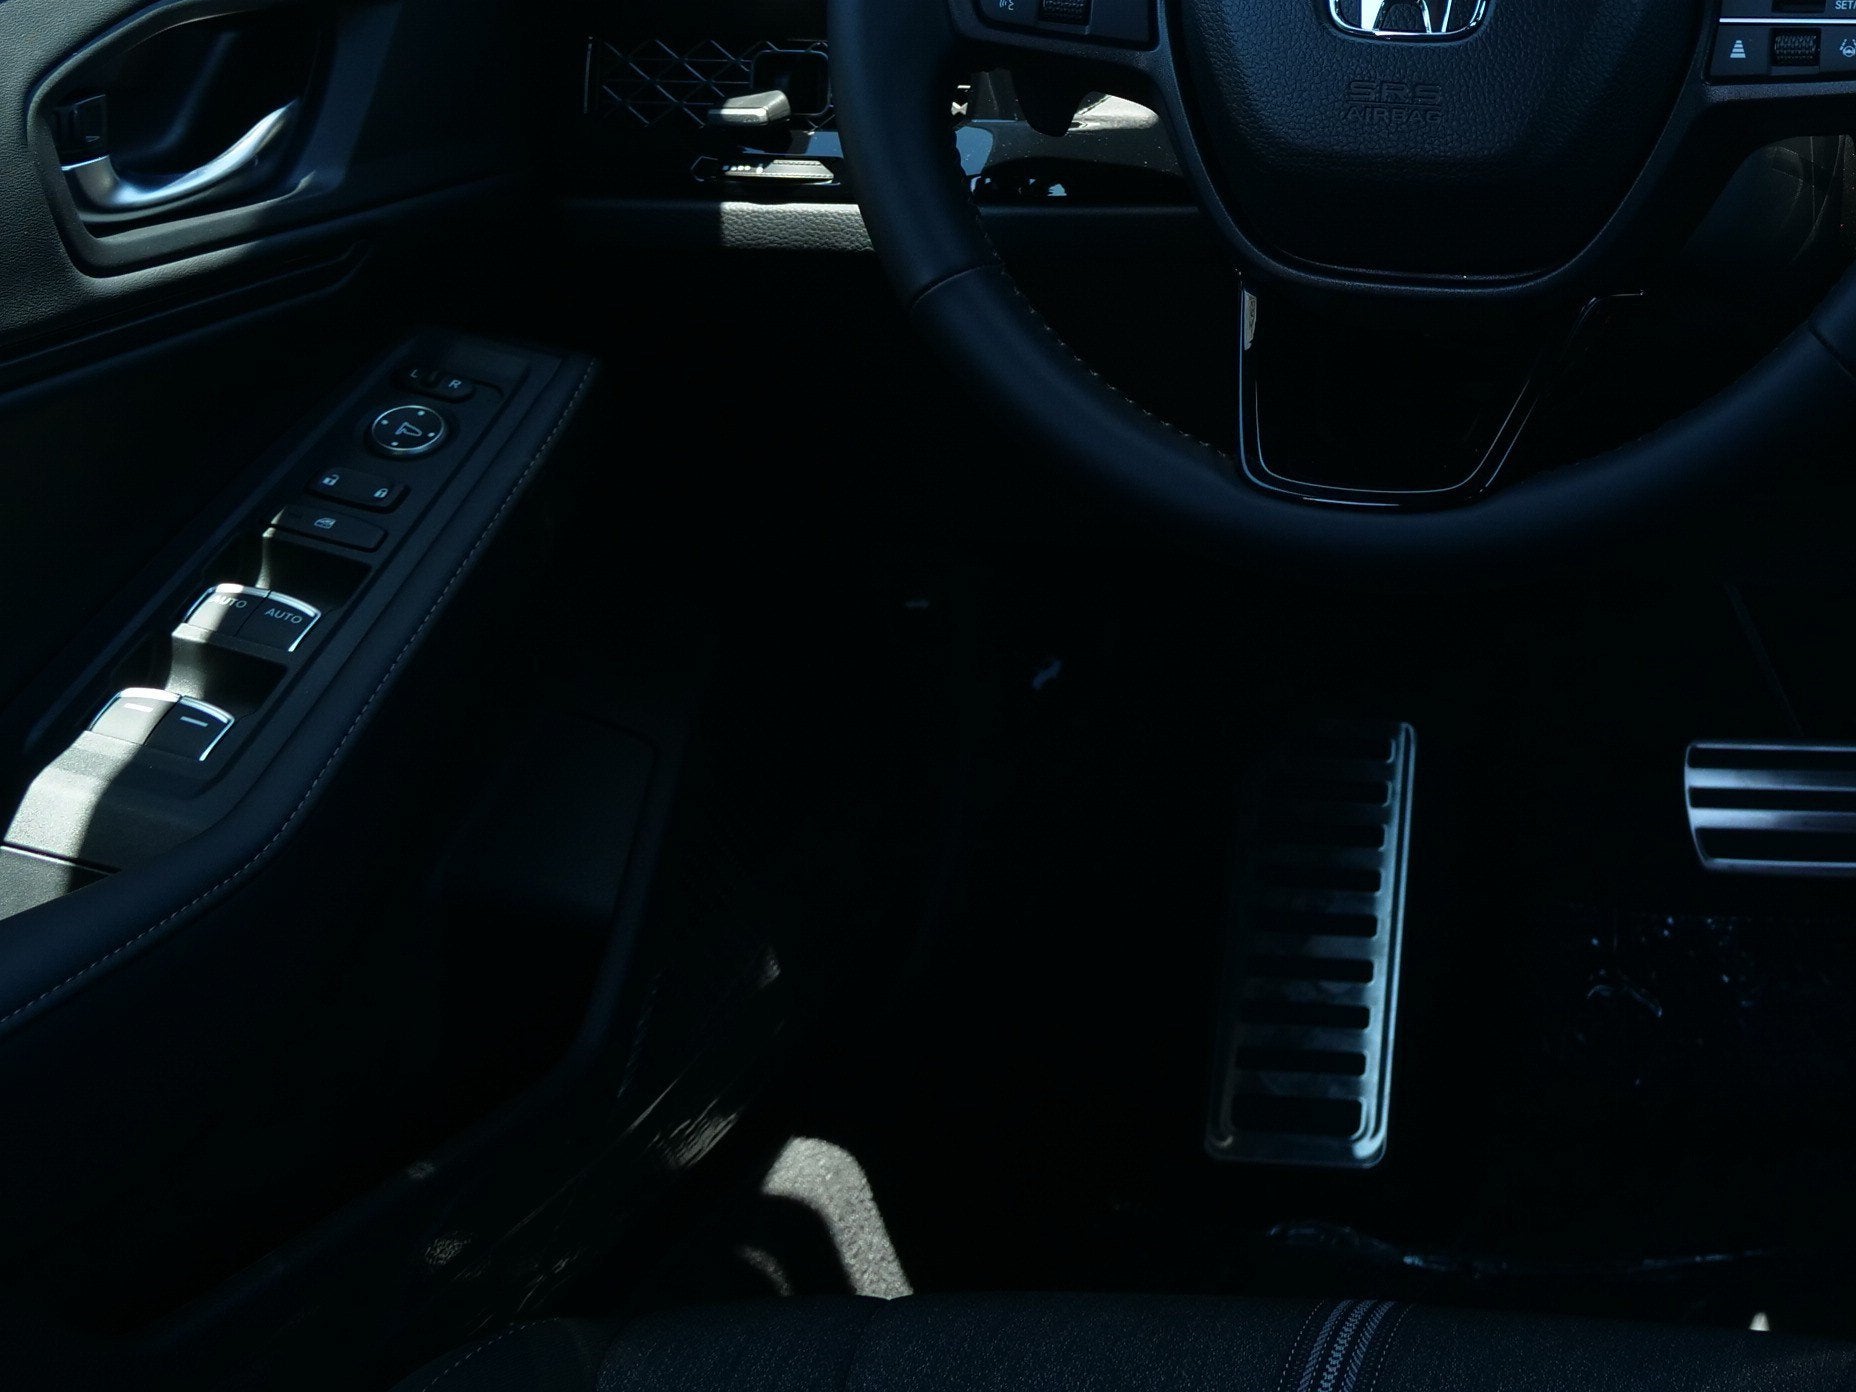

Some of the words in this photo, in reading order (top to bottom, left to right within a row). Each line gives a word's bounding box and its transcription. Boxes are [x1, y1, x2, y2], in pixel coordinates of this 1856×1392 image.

[1348, 80, 1441, 105] SRS
[1347, 107, 1443, 124] AIRBAG
[448, 379, 462, 389] R
[265, 608, 302, 624] AUTO
